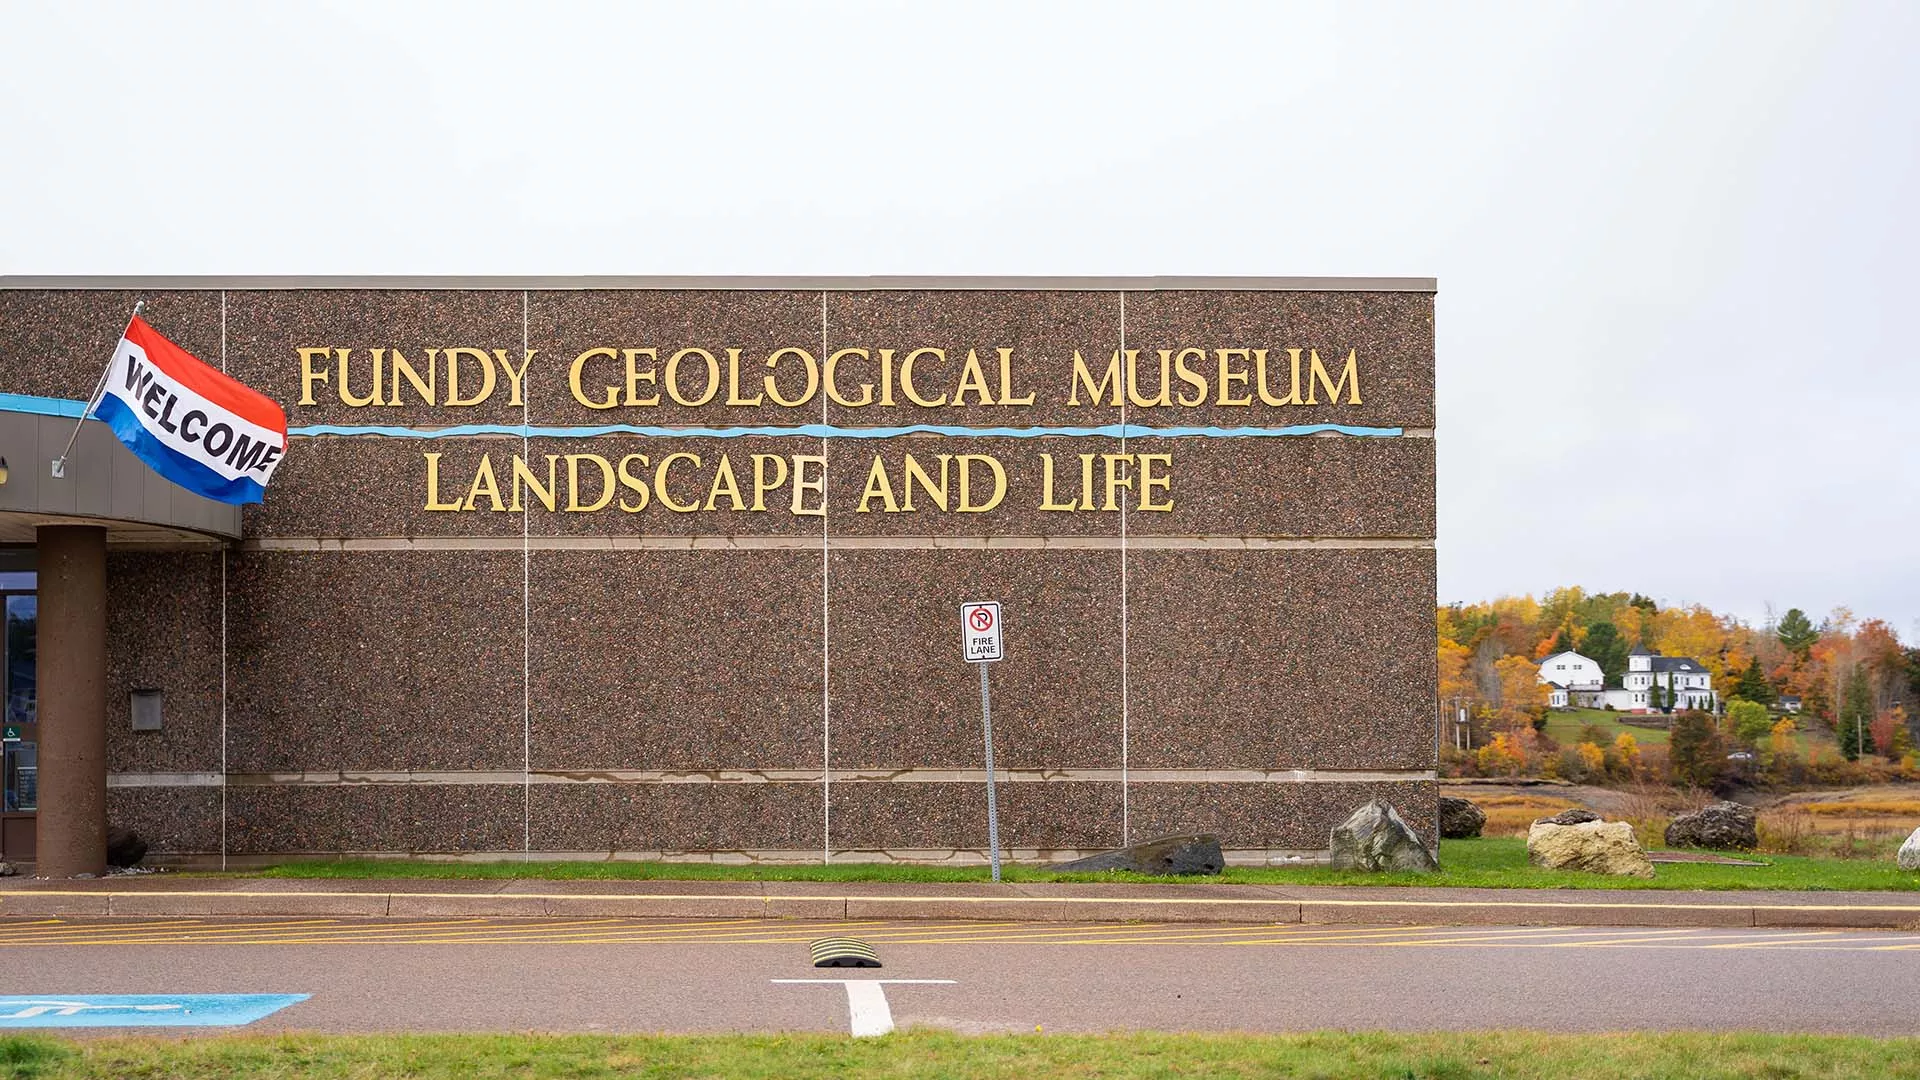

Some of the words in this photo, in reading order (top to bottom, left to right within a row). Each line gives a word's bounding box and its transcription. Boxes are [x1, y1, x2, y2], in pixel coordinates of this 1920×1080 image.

[297, 346, 537, 407] FUNDY
[568, 347, 1036, 410] GEOLOGICAL
[1066, 347, 1363, 408] MUSEUM
[125, 355, 282, 472] WELCOME
[422, 452, 828, 517] LANDSCAPE
[856, 453, 1007, 513] AND
[1039, 453, 1174, 512] LIFE
[970, 645, 996, 655] LANE
[972, 637, 994, 646] FIRE
